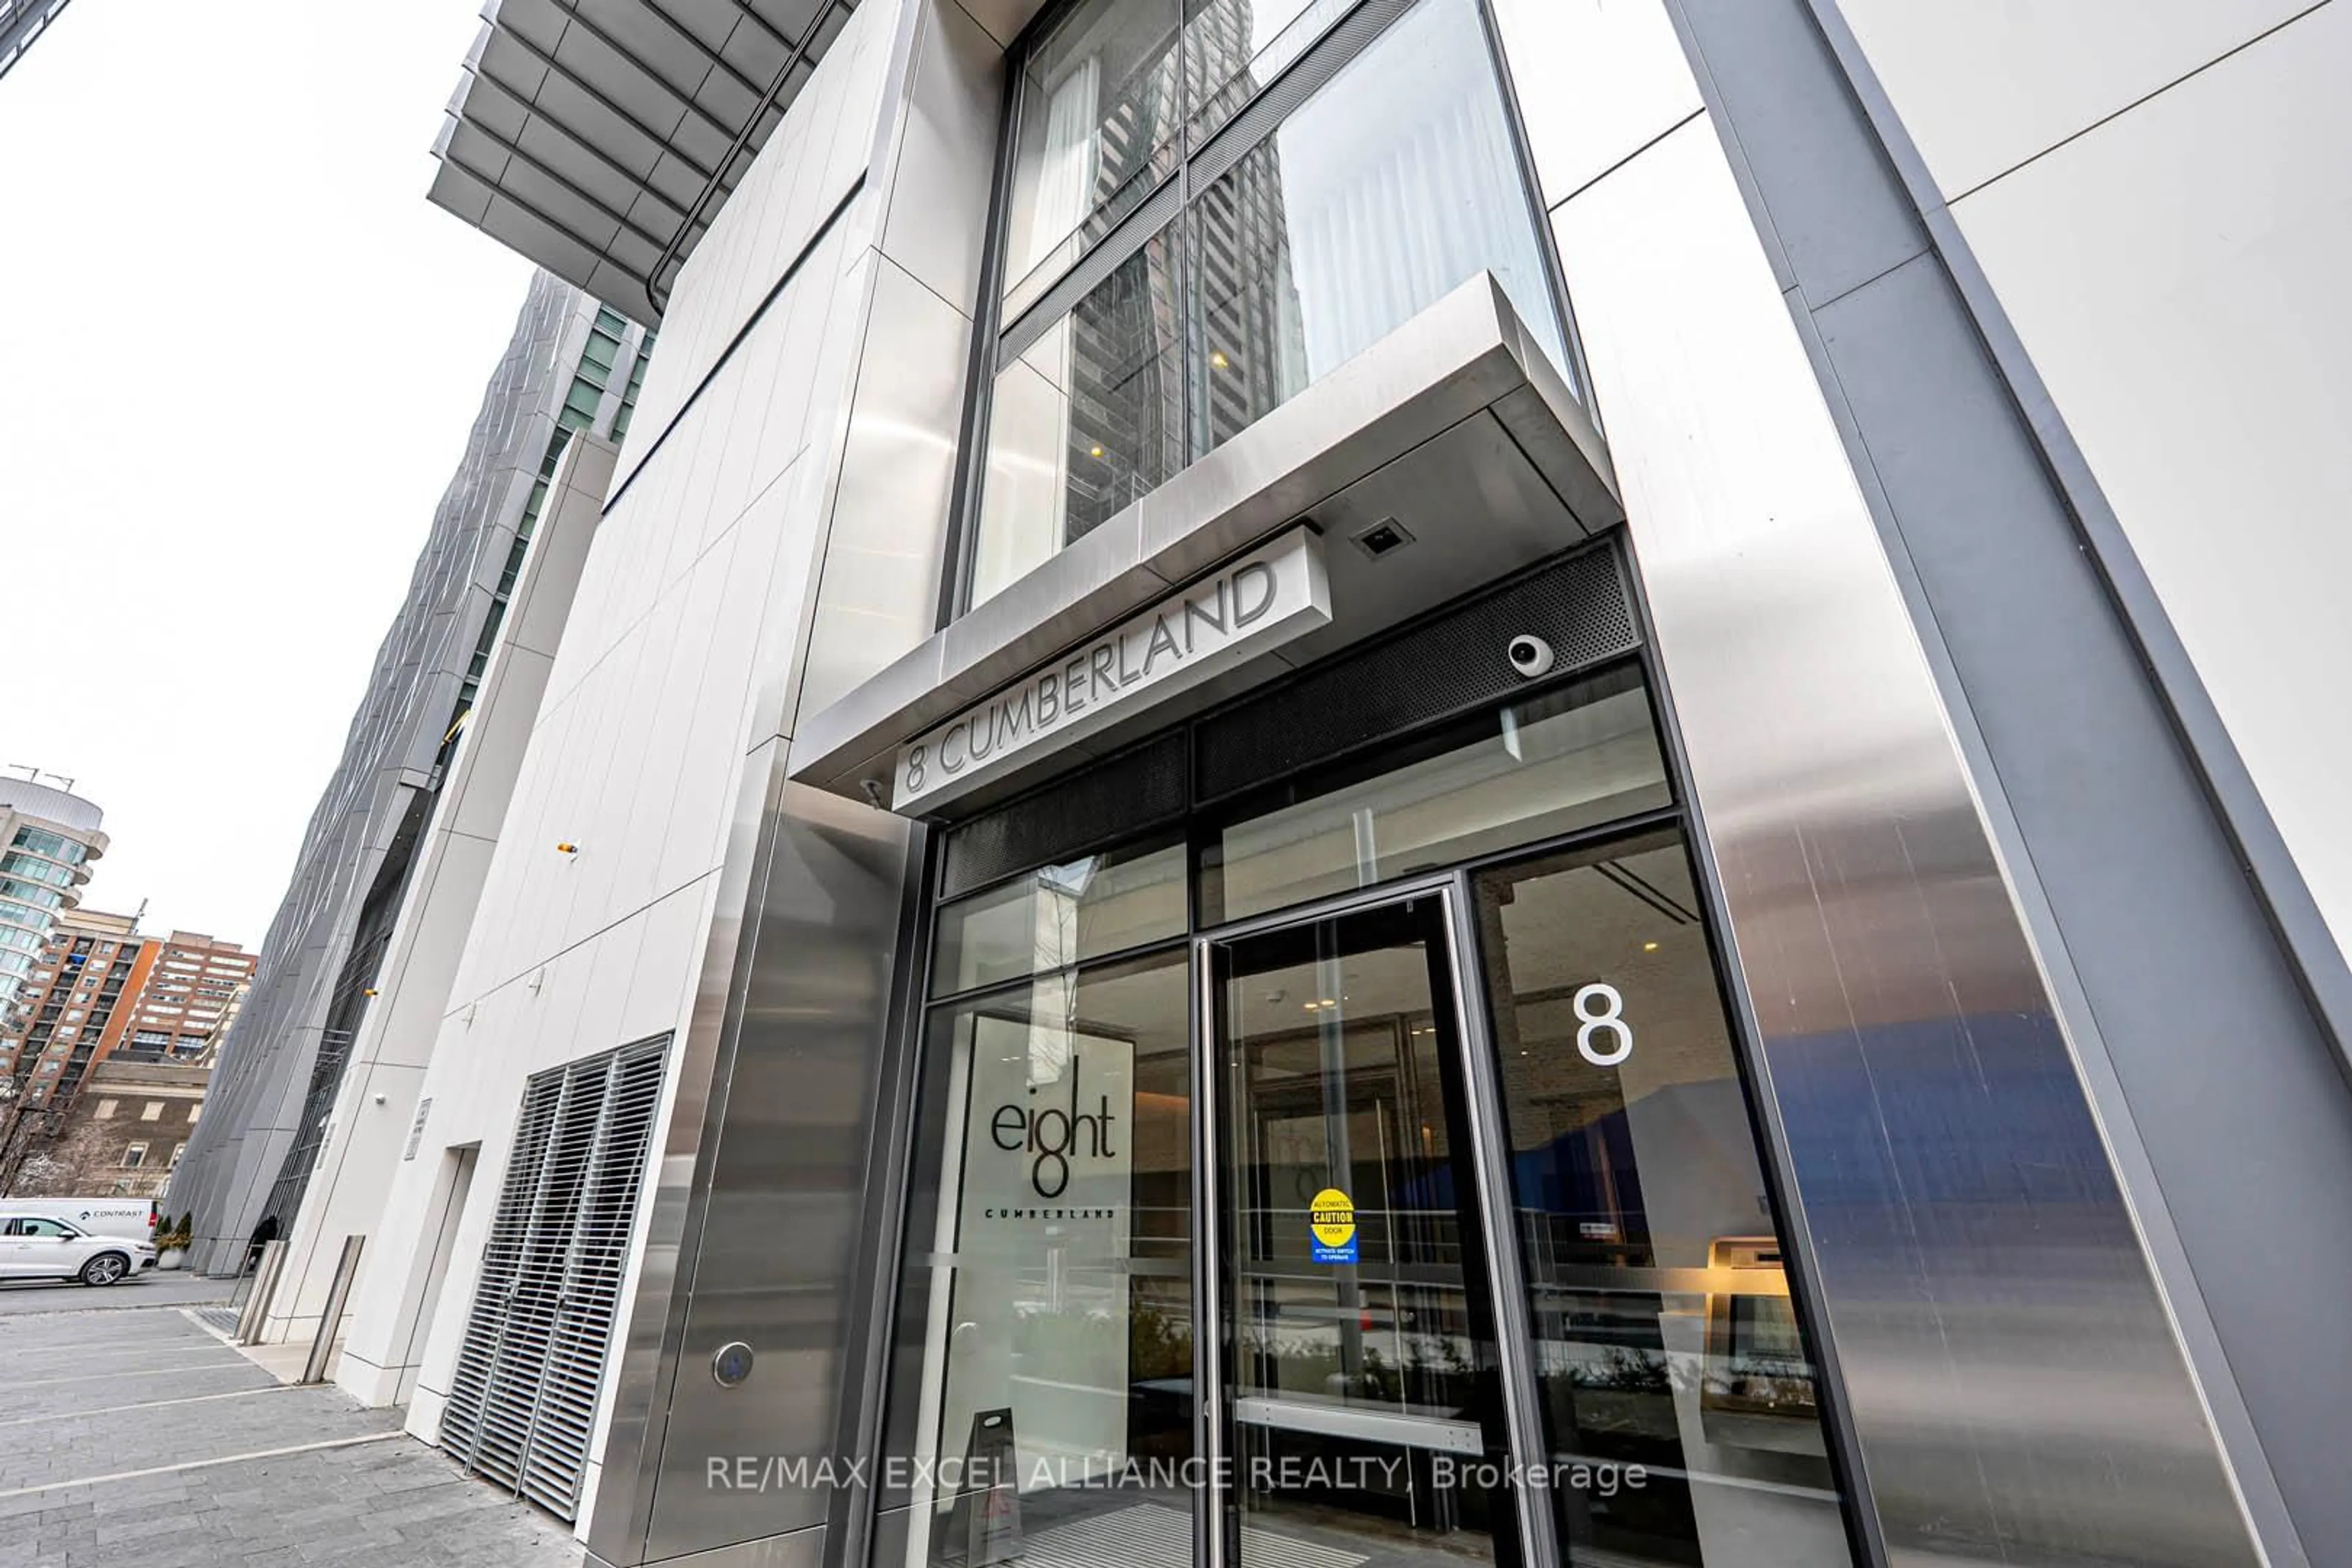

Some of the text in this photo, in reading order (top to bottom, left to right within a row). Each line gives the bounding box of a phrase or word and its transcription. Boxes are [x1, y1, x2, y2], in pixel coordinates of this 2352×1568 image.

[906, 561, 1278, 793] 8 CUMBERLAND
[1574, 983, 1633, 1066] 8
[991, 1055, 1116, 1199] eight
[985, 1208, 1114, 1219] CUMBERLAND
[1313, 1212, 1354, 1223] CAUTION
